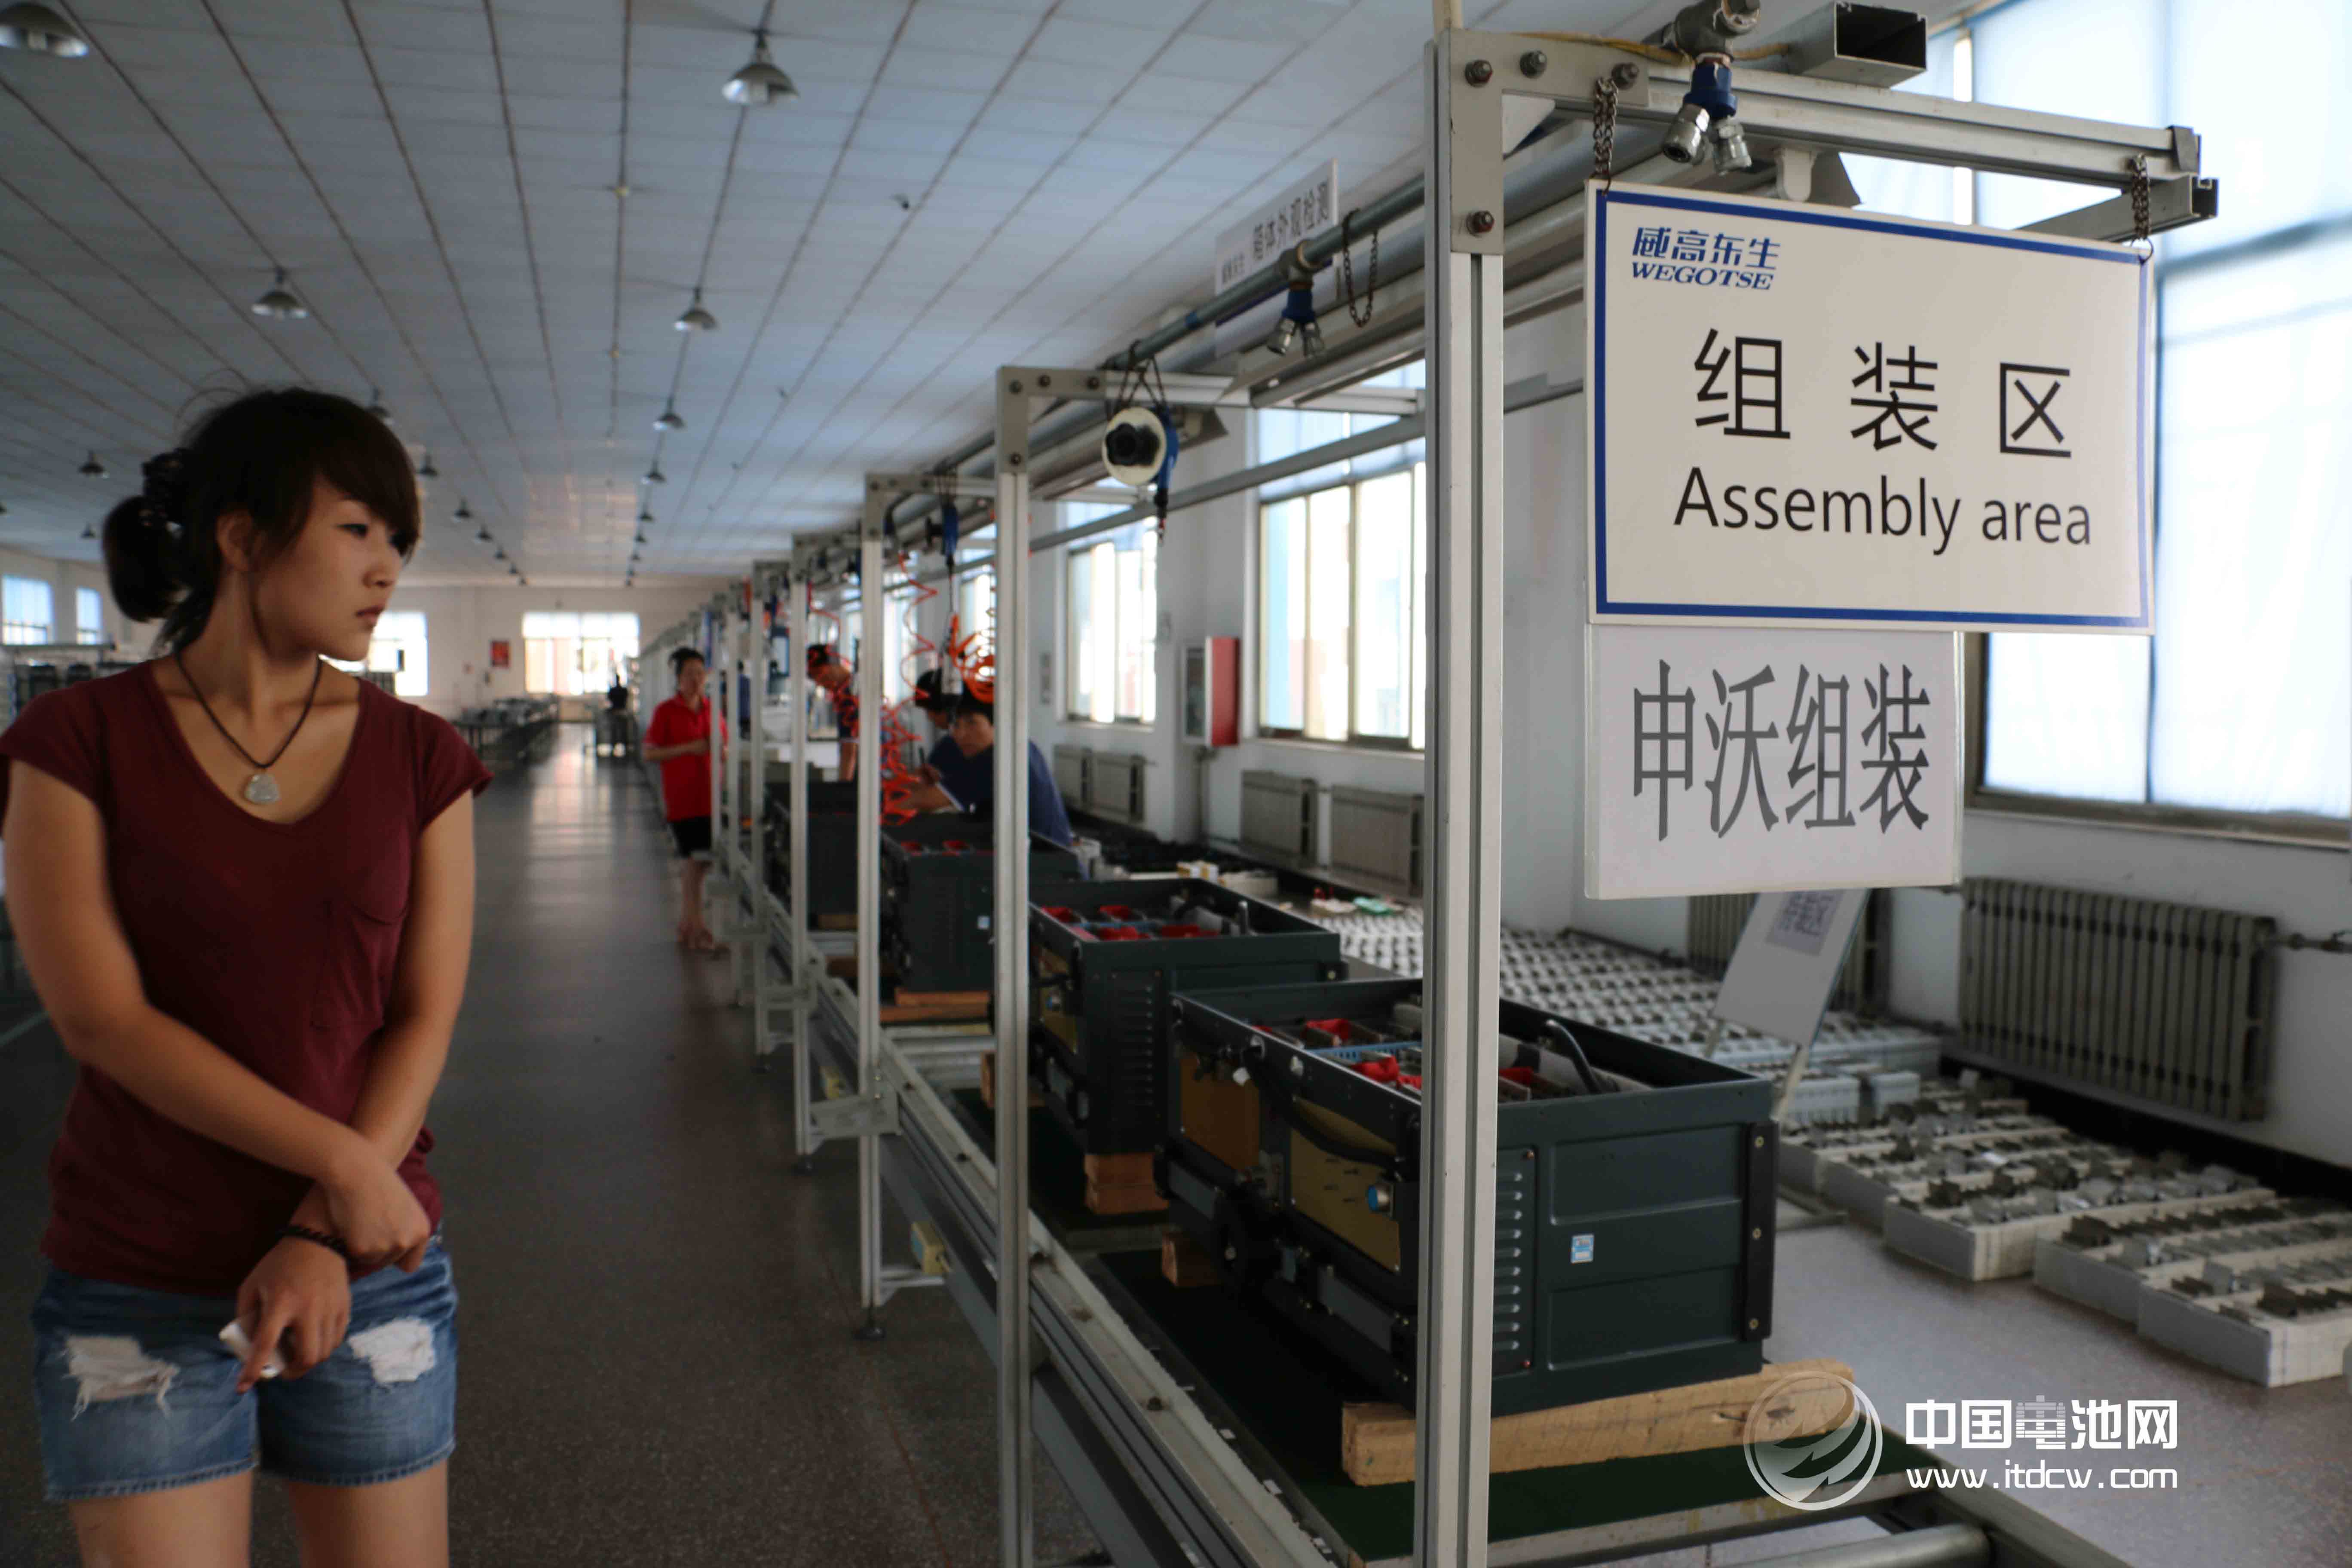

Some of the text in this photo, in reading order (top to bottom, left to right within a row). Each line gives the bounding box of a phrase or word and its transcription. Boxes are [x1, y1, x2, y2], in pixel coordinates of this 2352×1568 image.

[1632, 227, 1780, 270] 威高东生
[1632, 262, 1774, 290] WEGOTSE
[1694, 328, 2071, 458] 组装区
[1673, 466, 2091, 556] Assembly area
[1633, 659, 1931, 841] 申沃组装
